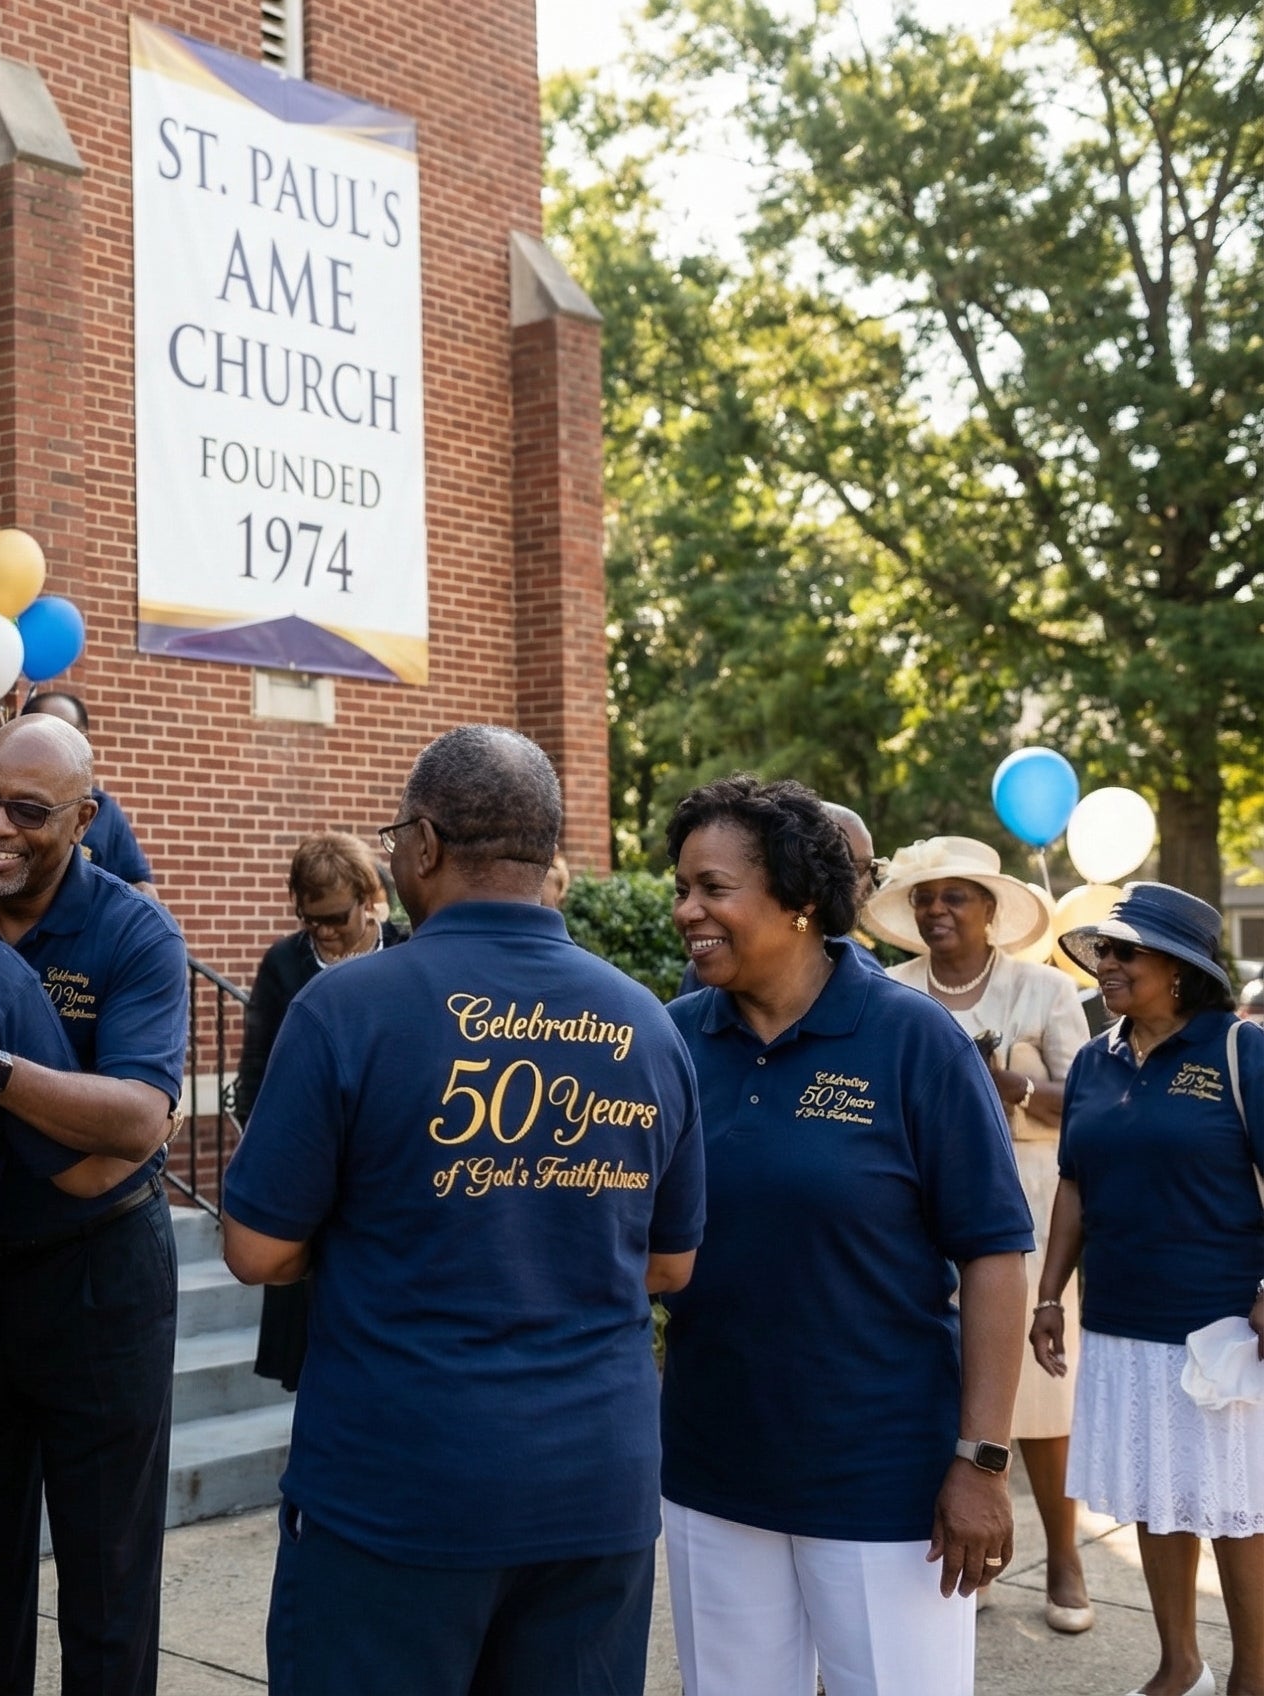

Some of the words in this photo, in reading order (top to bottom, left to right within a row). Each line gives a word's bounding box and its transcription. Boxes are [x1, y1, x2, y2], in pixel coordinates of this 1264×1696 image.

[158, 117, 227, 195] ST.
[248, 144, 402, 248] PAUL'S
[215, 228, 357, 335] AME
[168, 323, 401, 434] CHURCH
[199, 436, 381, 509] FOUNDED
[237, 512, 353, 594] 1974
[447, 993, 634, 1061] Celebrating
[429, 1058, 543, 1145] 50
[548, 1075, 658, 1146] Years
[799, 1086, 834, 1107] 50
[433, 1160, 464, 1198] of
[465, 1157, 529, 1197] God's
[533, 1156, 650, 1197] Faithfulness
